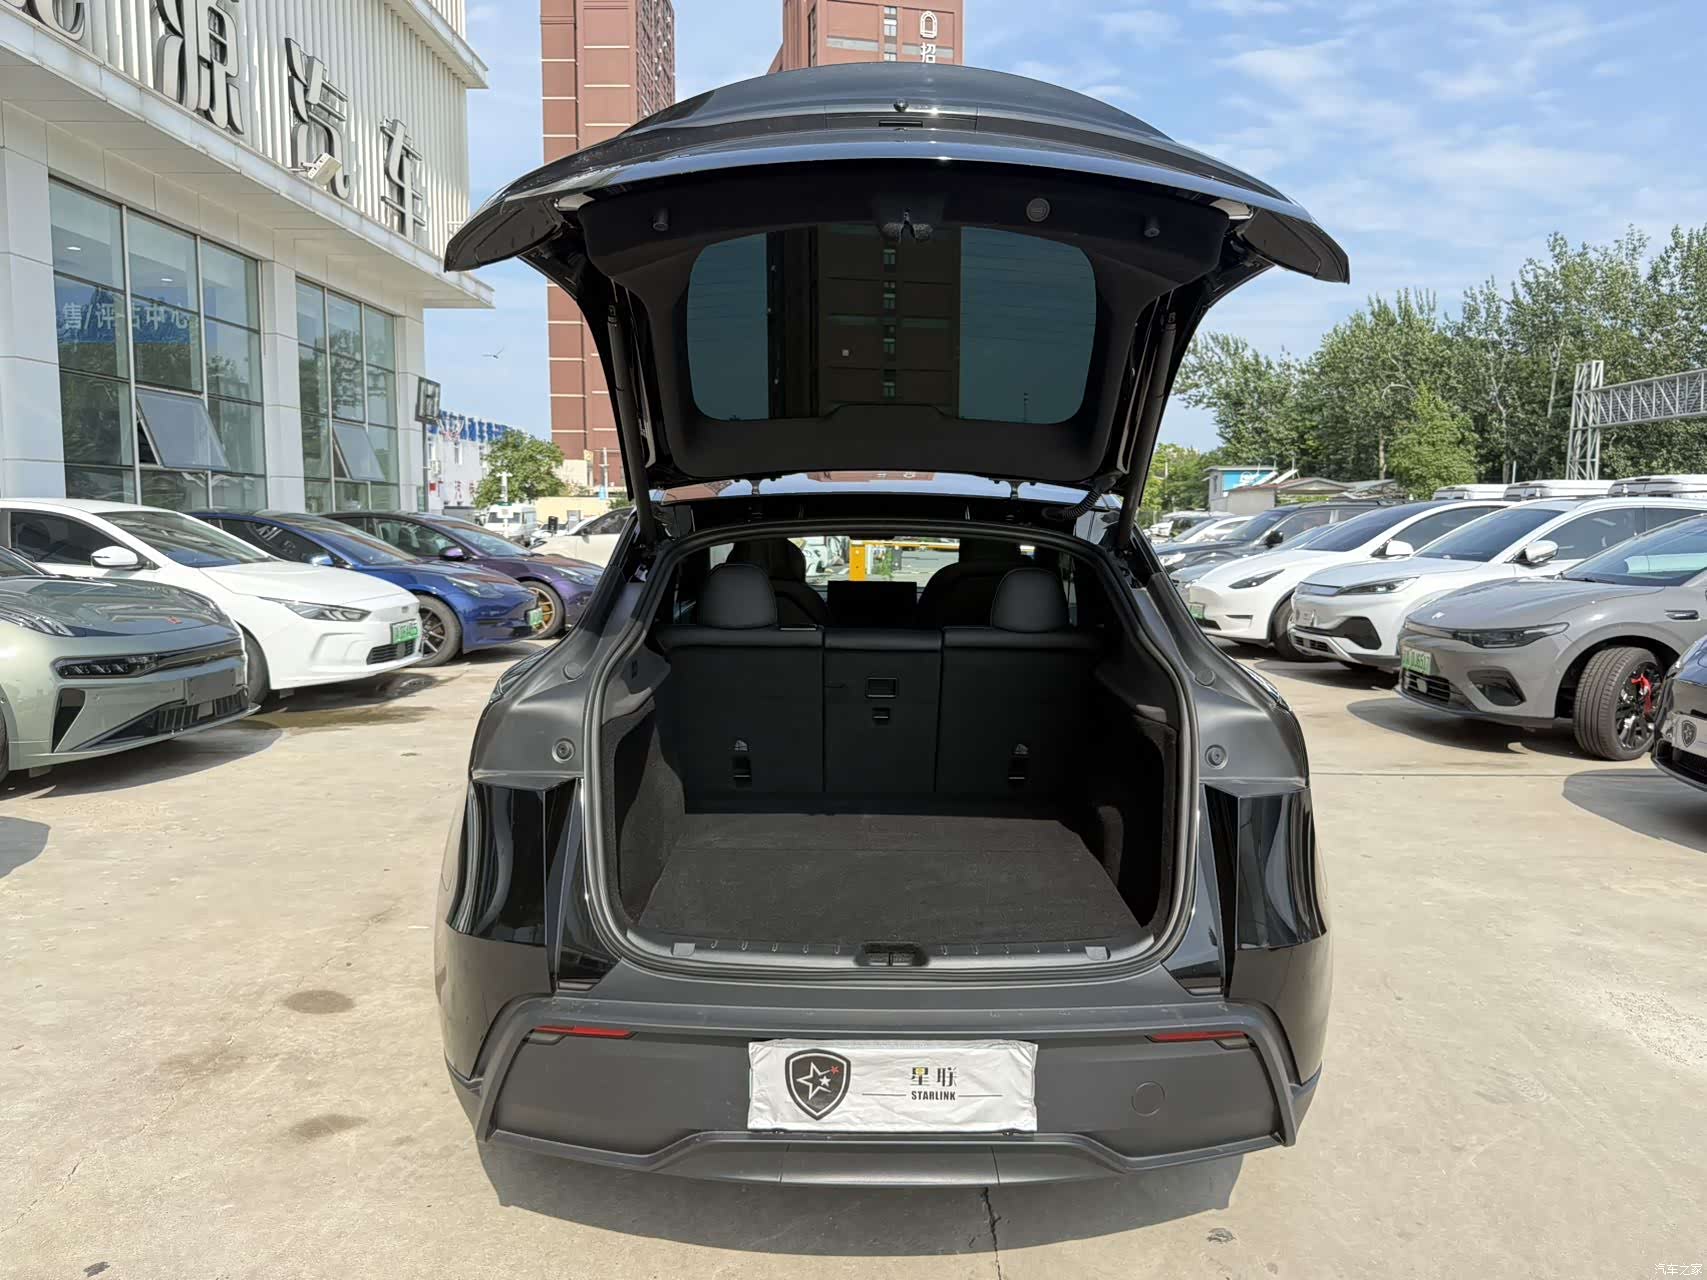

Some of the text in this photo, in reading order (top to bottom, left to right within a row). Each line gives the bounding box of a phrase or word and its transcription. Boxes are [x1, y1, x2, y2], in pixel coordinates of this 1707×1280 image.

[920, 42, 936, 63] 招
[5, 0, 428, 241] 源汽车
[911, 1091, 956, 1101] STARLINK
